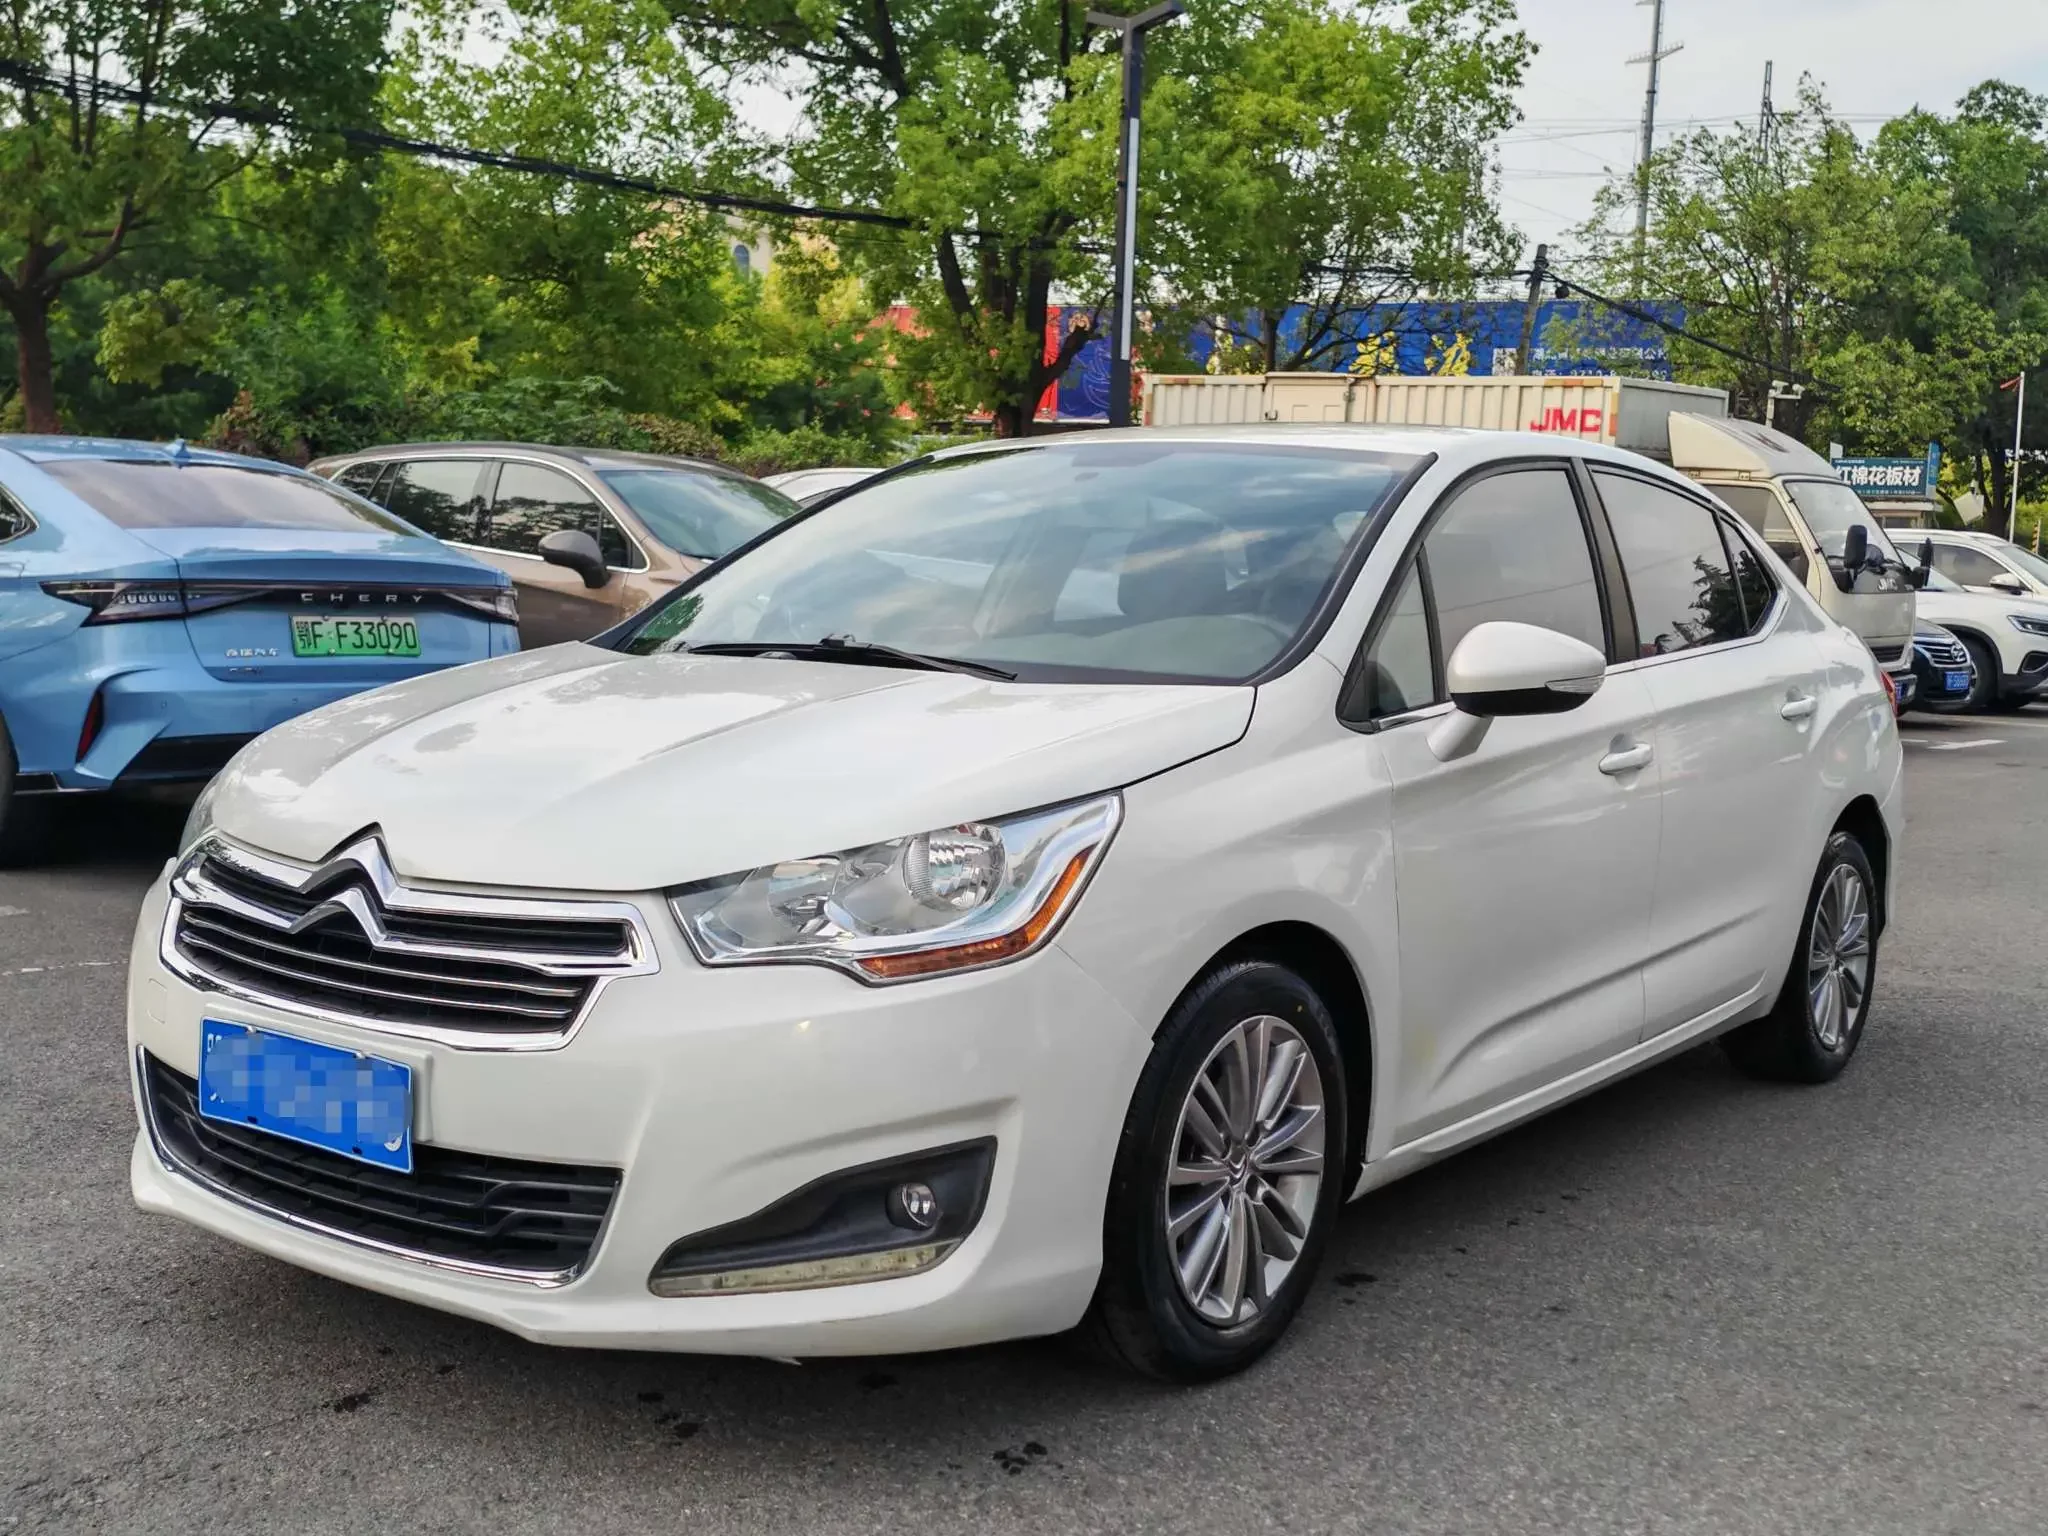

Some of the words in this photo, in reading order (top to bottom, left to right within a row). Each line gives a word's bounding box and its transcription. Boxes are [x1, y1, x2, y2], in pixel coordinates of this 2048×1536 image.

[1530, 408, 1602, 432] JMC
[1835, 465, 1921, 487] 红棉花板材
[301, 592, 422, 603] CHERY
